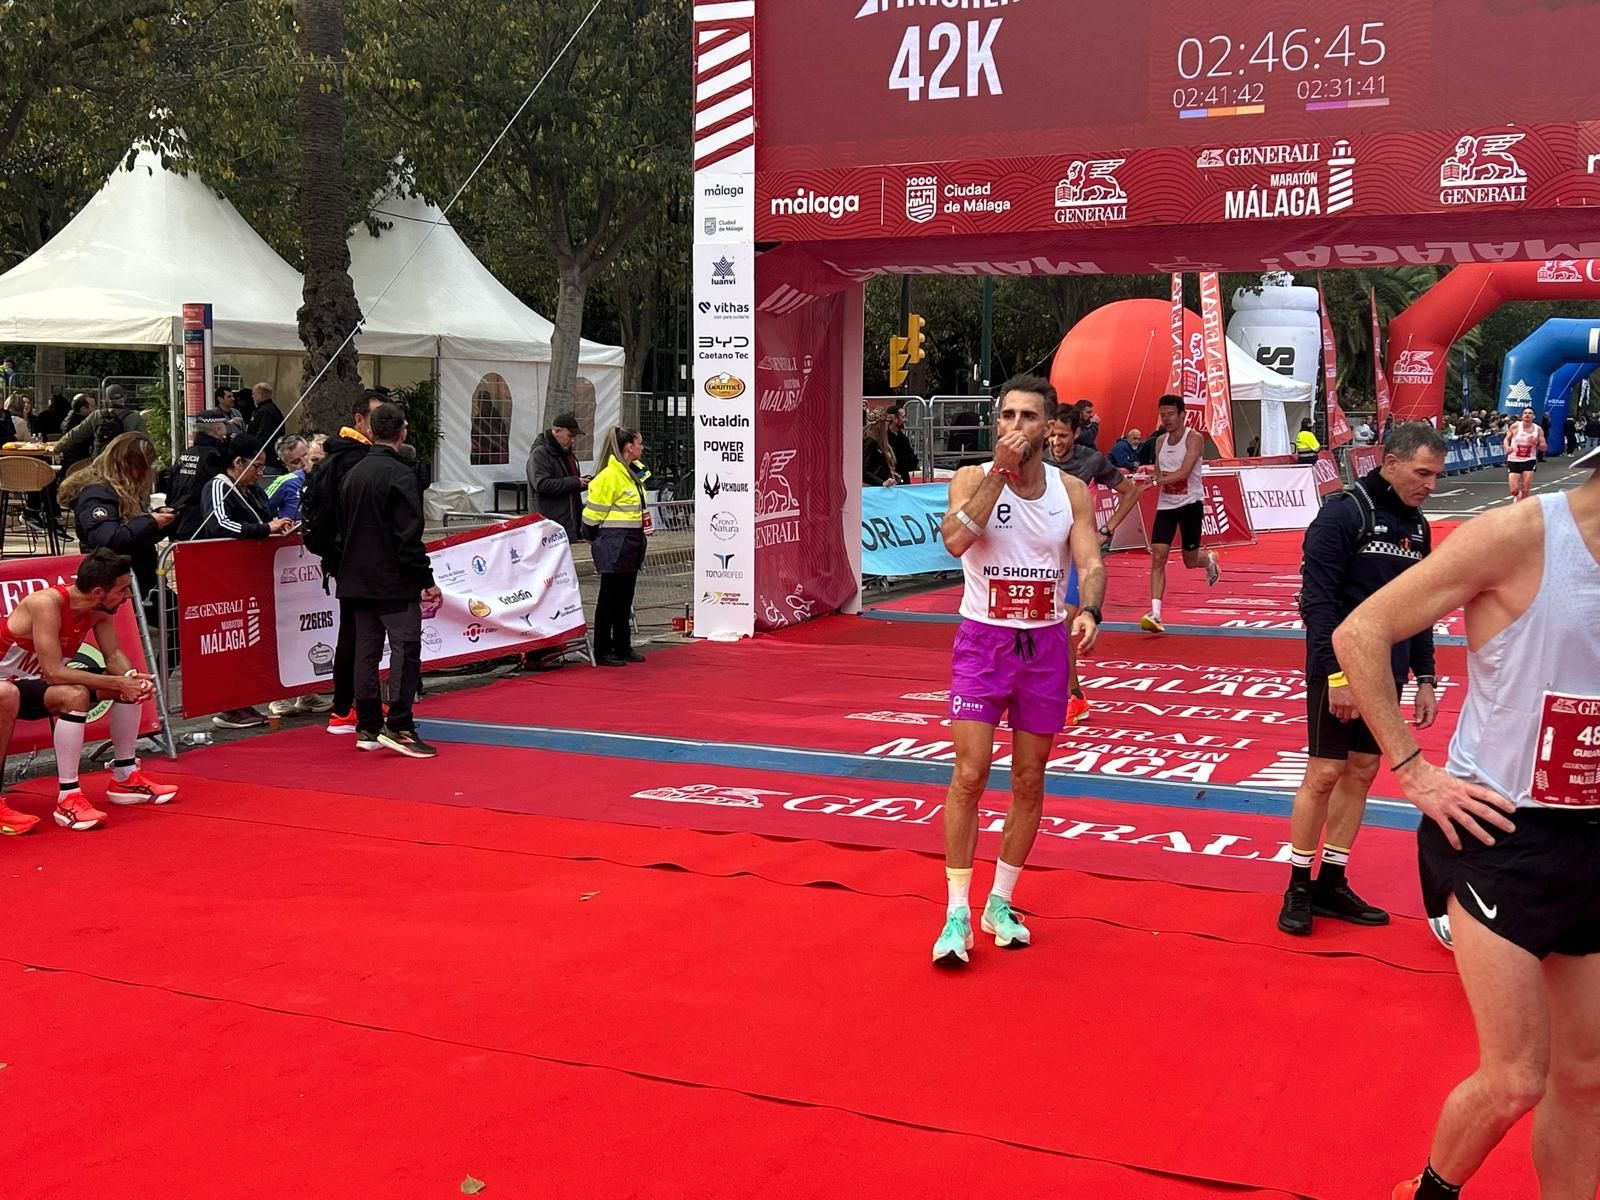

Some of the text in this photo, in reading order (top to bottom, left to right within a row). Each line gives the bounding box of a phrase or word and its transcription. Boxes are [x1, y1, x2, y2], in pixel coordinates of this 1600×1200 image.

[888, 17, 1004, 102] 42K
[1176, 21, 1387, 80] 02:46:45
[1172, 82, 1265, 109] 02:41:42
[1296, 74, 1386, 101] 02:31:41
[1226, 142, 1321, 167] GENERALI
[1270, 169, 1318, 187] MARATÓN
[943, 181, 991, 198] Ciudad
[1439, 186, 1528, 205] GENERALI
[943, 198, 1011, 214] de Málaga
[1224, 183, 1321, 220] MÁLAGA
[1054, 204, 1128, 224] GENERALI
[711, 277, 736, 286] luanvi
[713, 302, 750, 313] vithas
[698, 335, 749, 348] BYD
[698, 351, 749, 360] Caetano Tec
[699, 414, 750, 428] Vitaldin
[703, 440, 744, 452] POWER
[721, 451, 744, 462] ADE
[1246, 489, 1307, 508] ENERALI
[862, 514, 927, 552] ORLD
[1200, 514, 1220, 536] AGA
[755, 520, 801, 549] ENERALI
[983, 565, 1000, 576] NO
[1008, 584, 1035, 598] 373
[199, 599, 244, 617] GENERALI
[299, 610, 334, 632] 226ERS
[200, 629, 247, 656] MÁLAGA
[1095, 659, 1308, 676] GENERA
[1199, 673, 1308, 686] MARAT
[1056, 741, 1231, 763] MARATÓN
